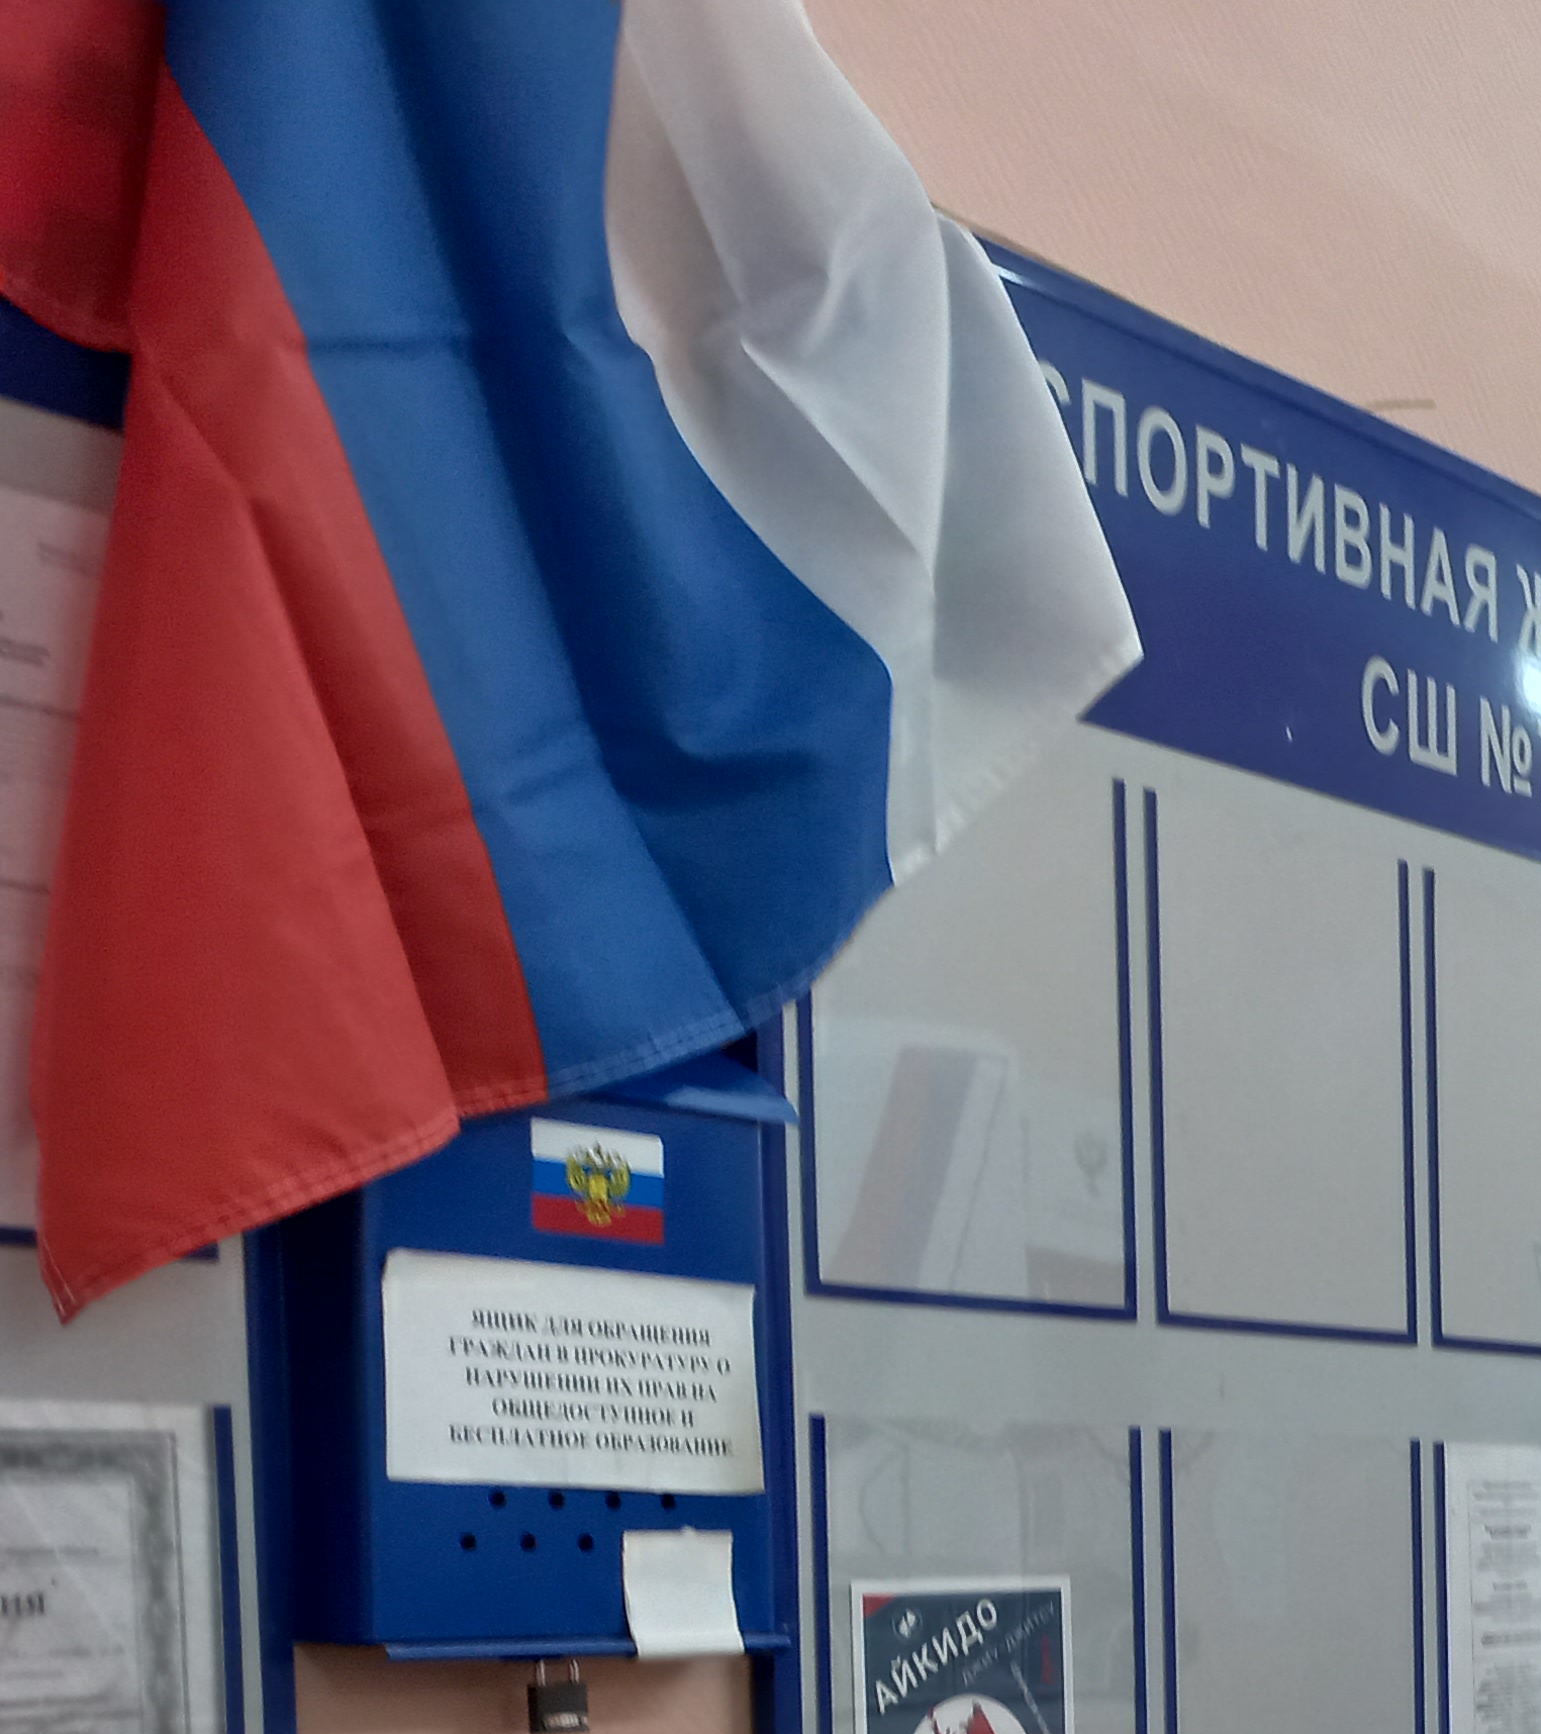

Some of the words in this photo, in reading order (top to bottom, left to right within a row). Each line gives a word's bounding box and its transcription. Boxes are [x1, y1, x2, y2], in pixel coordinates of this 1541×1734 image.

[1038, 359, 1499, 643] ПОРТИВНАЯ
[1361, 655, 1458, 778] СШ
[587, 1319, 710, 1348] ОБРАЩЕНИЯ
[449, 1335, 551, 1363] ГРАЖДАН
[574, 1345, 710, 1374] ПРОКУРАТУРУ
[716, 1357, 730, 1376] О
[465, 1365, 600, 1396] НАРУШЕНИИ
[638, 1377, 686, 1401] ПРАВ
[492, 1397, 674, 1427] ОБЩЕДОСТУПНОЕ
[449, 1422, 588, 1450] БЕСПЛАТНОЕ
[595, 1430, 734, 1458] ОБРАЗОВАНИЕ
[875, 1598, 998, 1716] АЙКИДО
